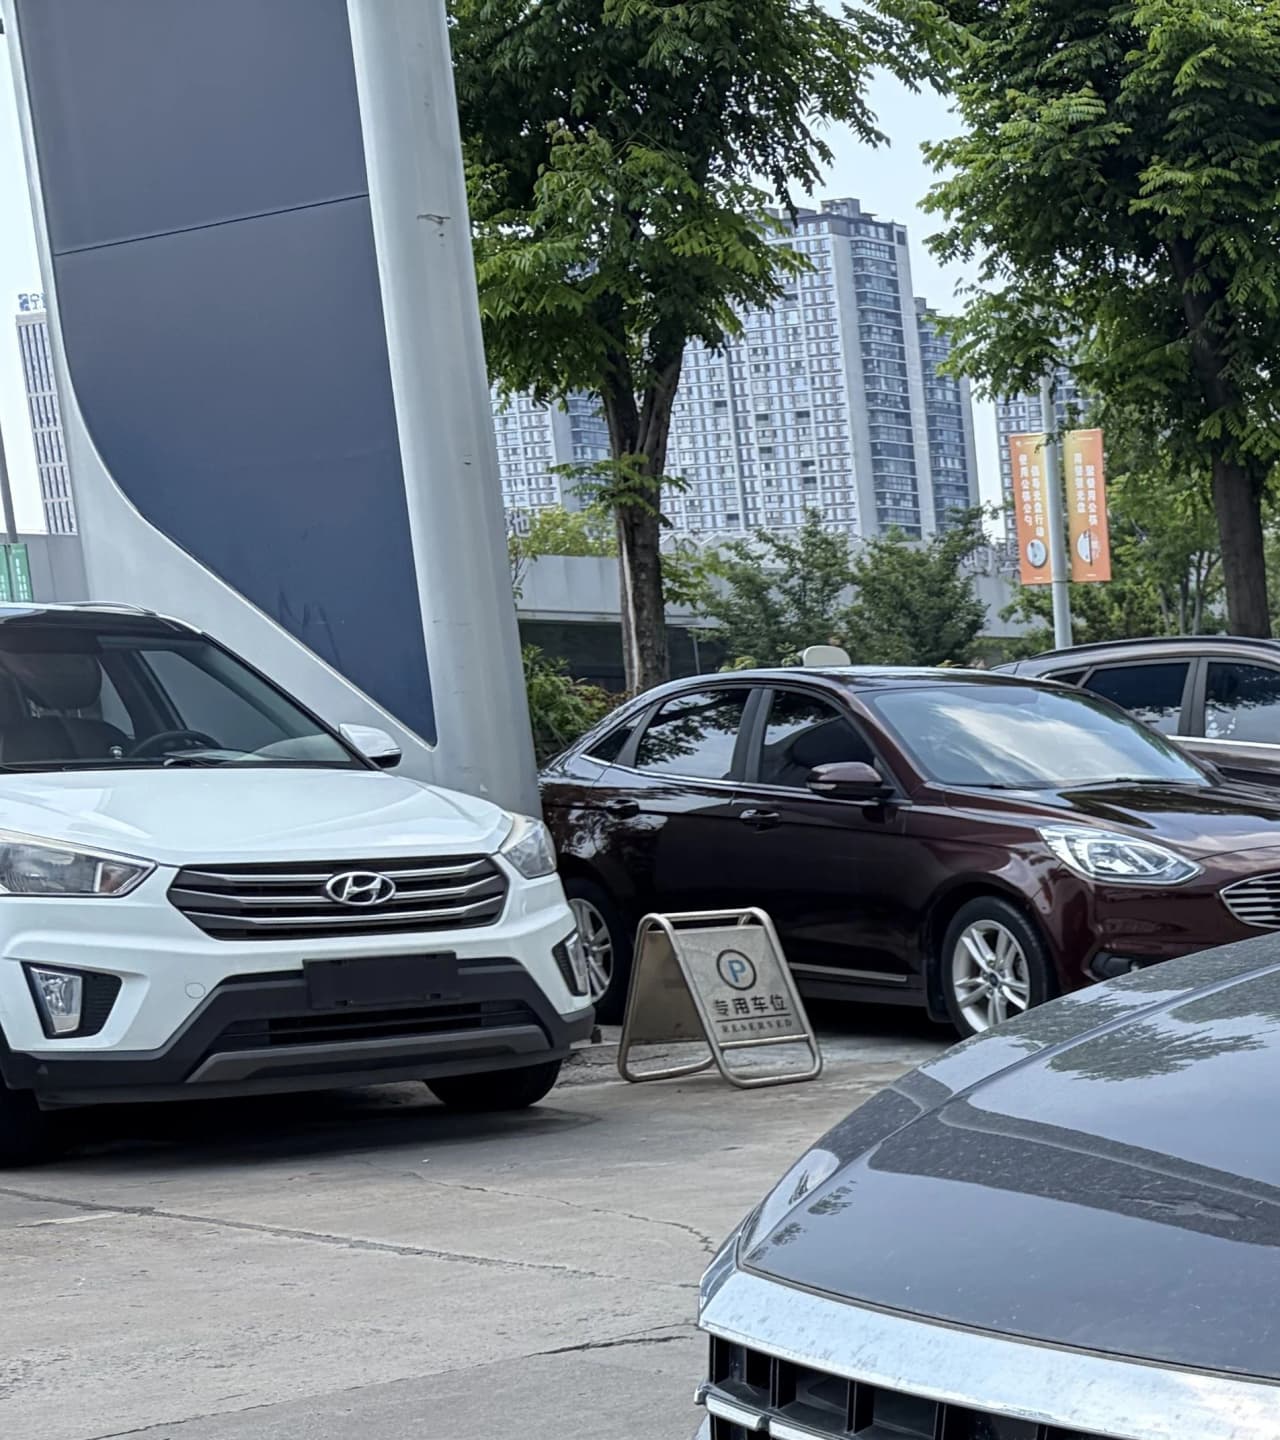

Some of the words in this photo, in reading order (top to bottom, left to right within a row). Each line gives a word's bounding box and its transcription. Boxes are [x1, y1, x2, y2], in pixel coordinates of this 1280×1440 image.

[727, 959, 747, 983] P
[713, 994, 788, 1017] 专用车位
[721, 1018, 793, 1034] RESERVED
